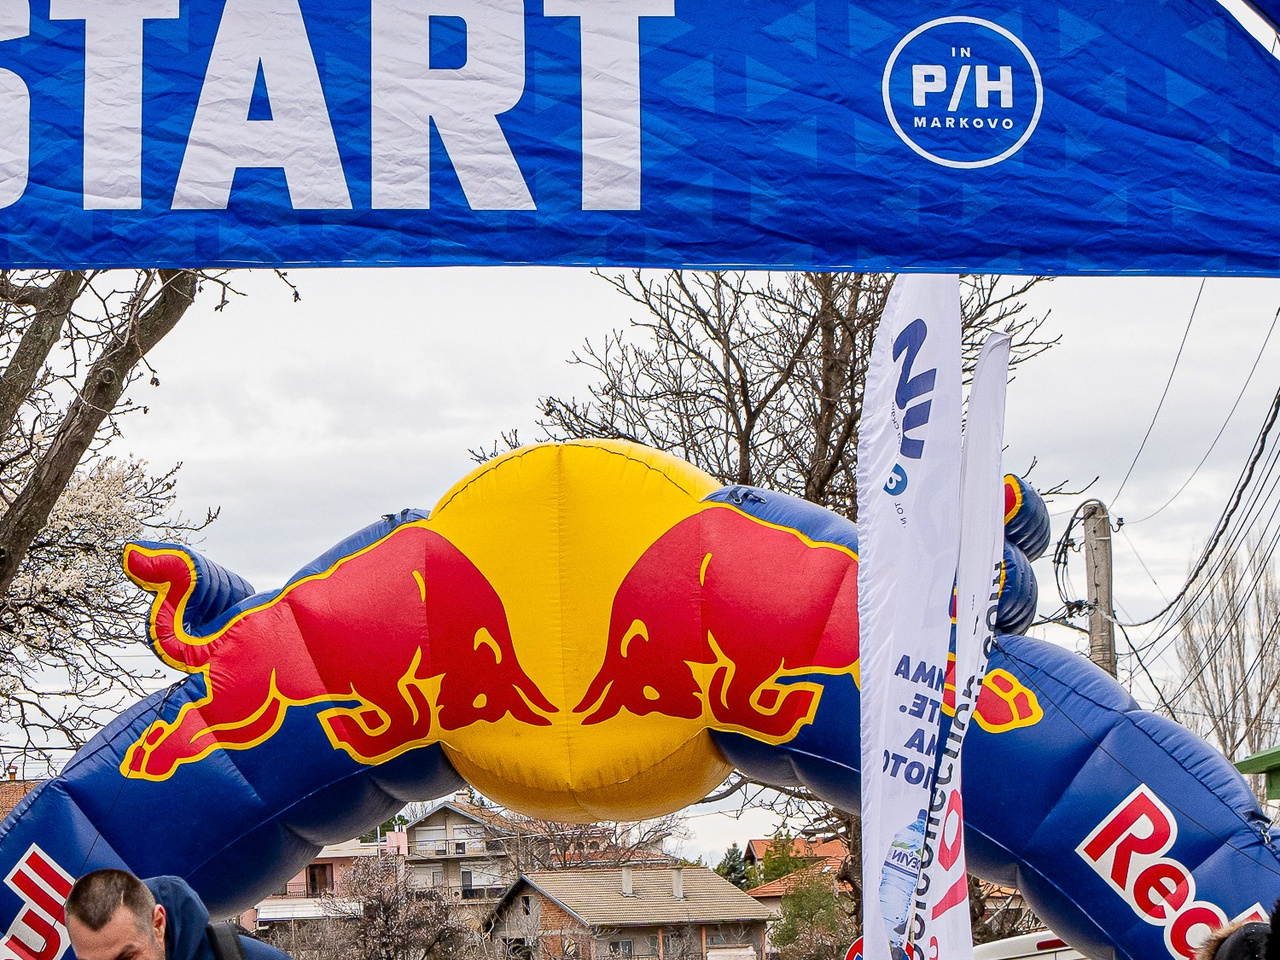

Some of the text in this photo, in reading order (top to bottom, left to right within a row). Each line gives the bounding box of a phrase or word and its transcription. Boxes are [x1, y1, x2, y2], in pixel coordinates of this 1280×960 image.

[951, 47, 971, 58] IN
[912, 64, 1013, 112] P/H
[914, 117, 1014, 129] MARKOVO
